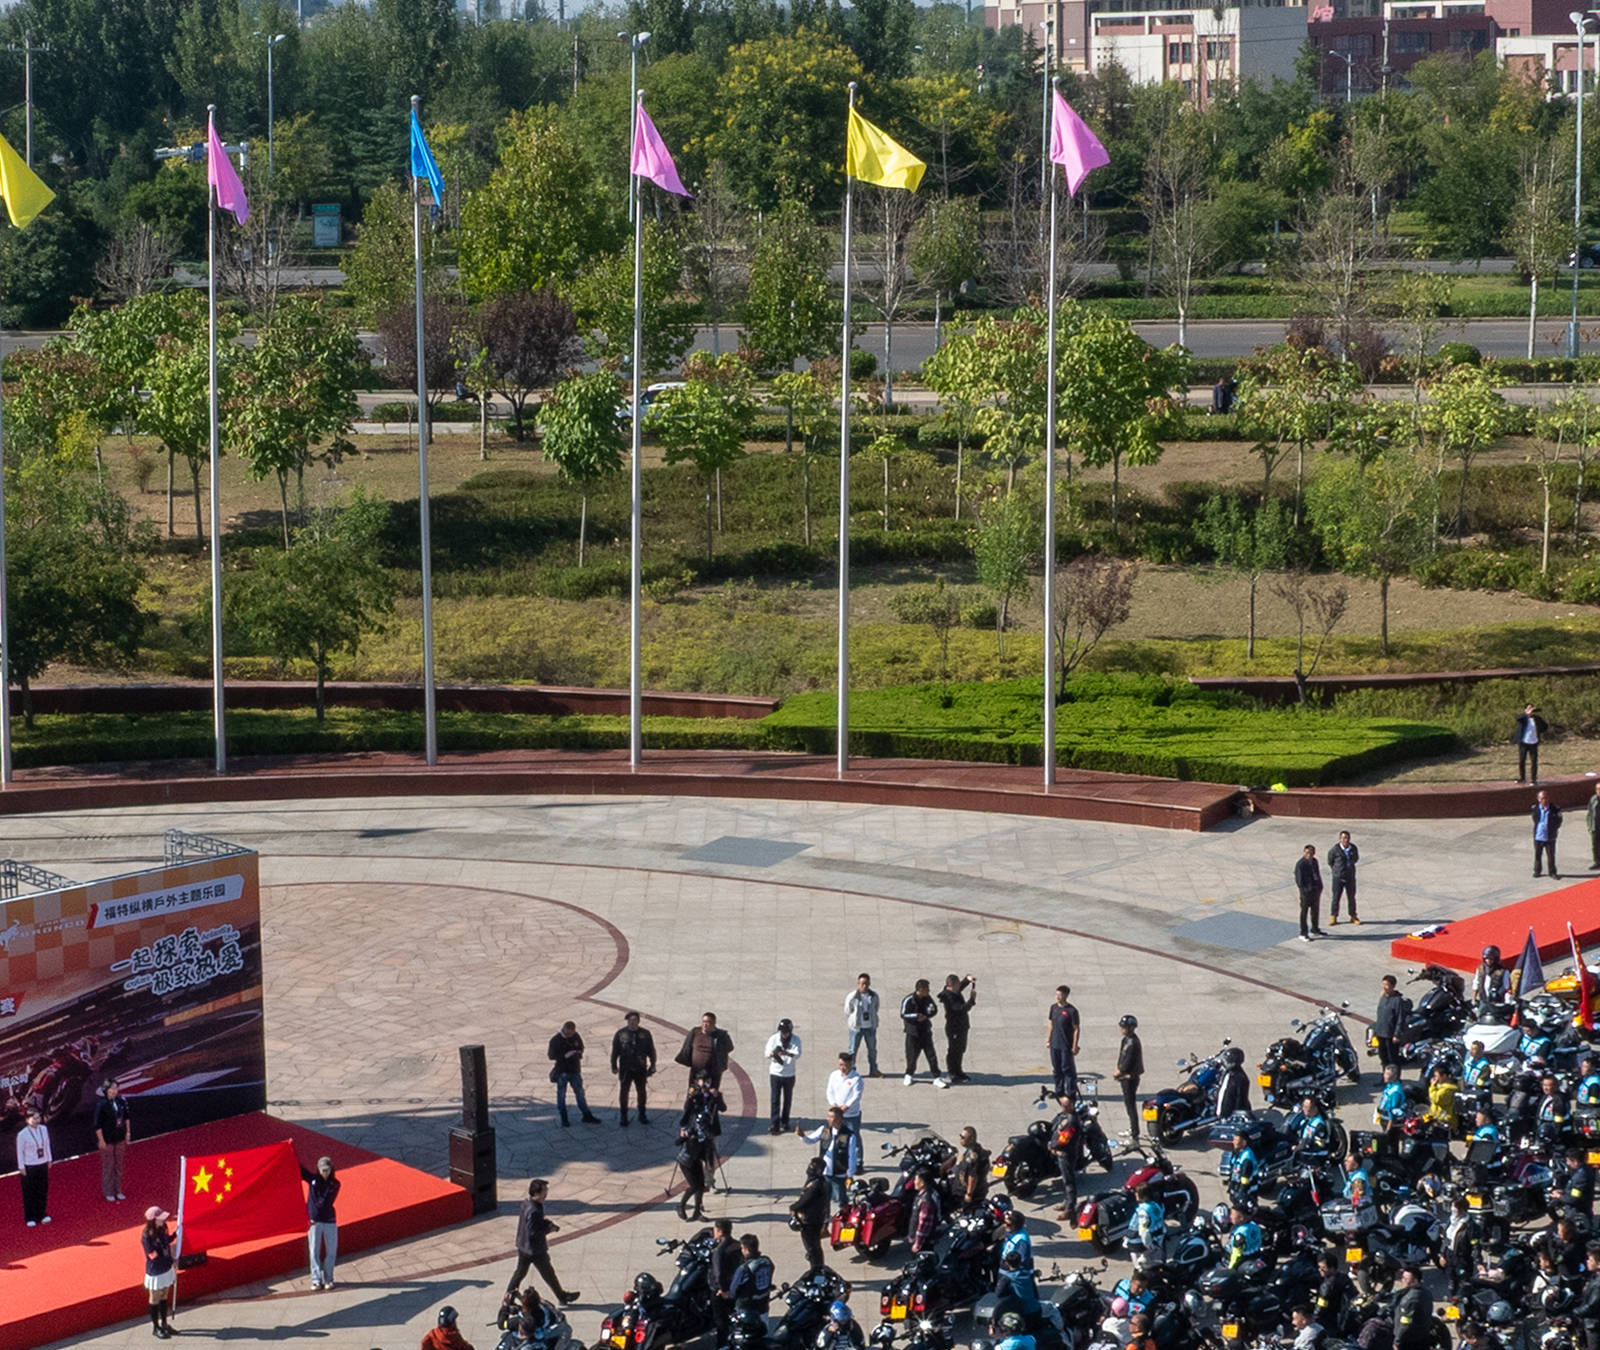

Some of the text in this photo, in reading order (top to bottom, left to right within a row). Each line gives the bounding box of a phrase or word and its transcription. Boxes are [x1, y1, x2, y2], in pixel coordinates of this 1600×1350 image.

[111, 927, 201, 973] 一起探索
[153, 943, 243, 994] 极致热爱
